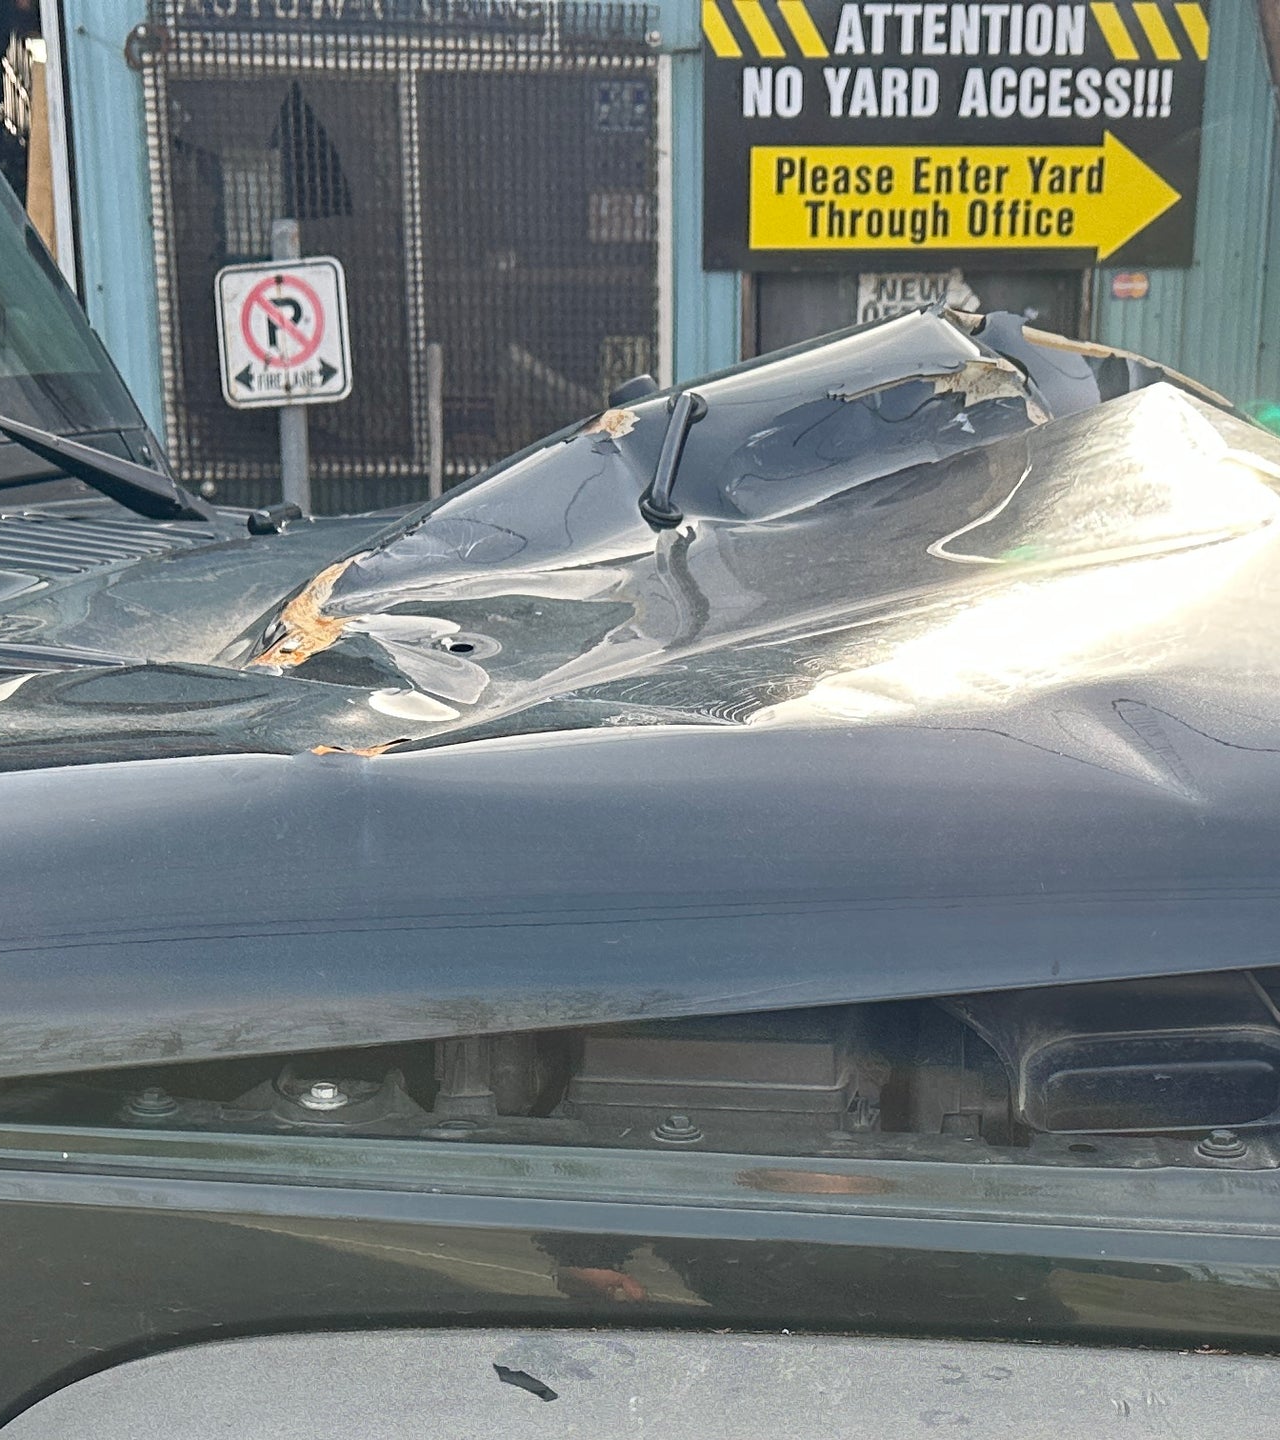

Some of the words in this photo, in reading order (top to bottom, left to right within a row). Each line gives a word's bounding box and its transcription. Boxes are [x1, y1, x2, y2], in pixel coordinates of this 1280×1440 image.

[834, 3, 1086, 56] ATTENTION
[743, 66, 804, 118] NO
[823, 67, 940, 118] YARD
[958, 68, 1174, 118] ACCESS!!!
[775, 157, 895, 196] Please
[913, 157, 1009, 195] Enter
[1027, 157, 1105, 195] Yard
[805, 200, 950, 244] Through
[968, 200, 1075, 238] Office
